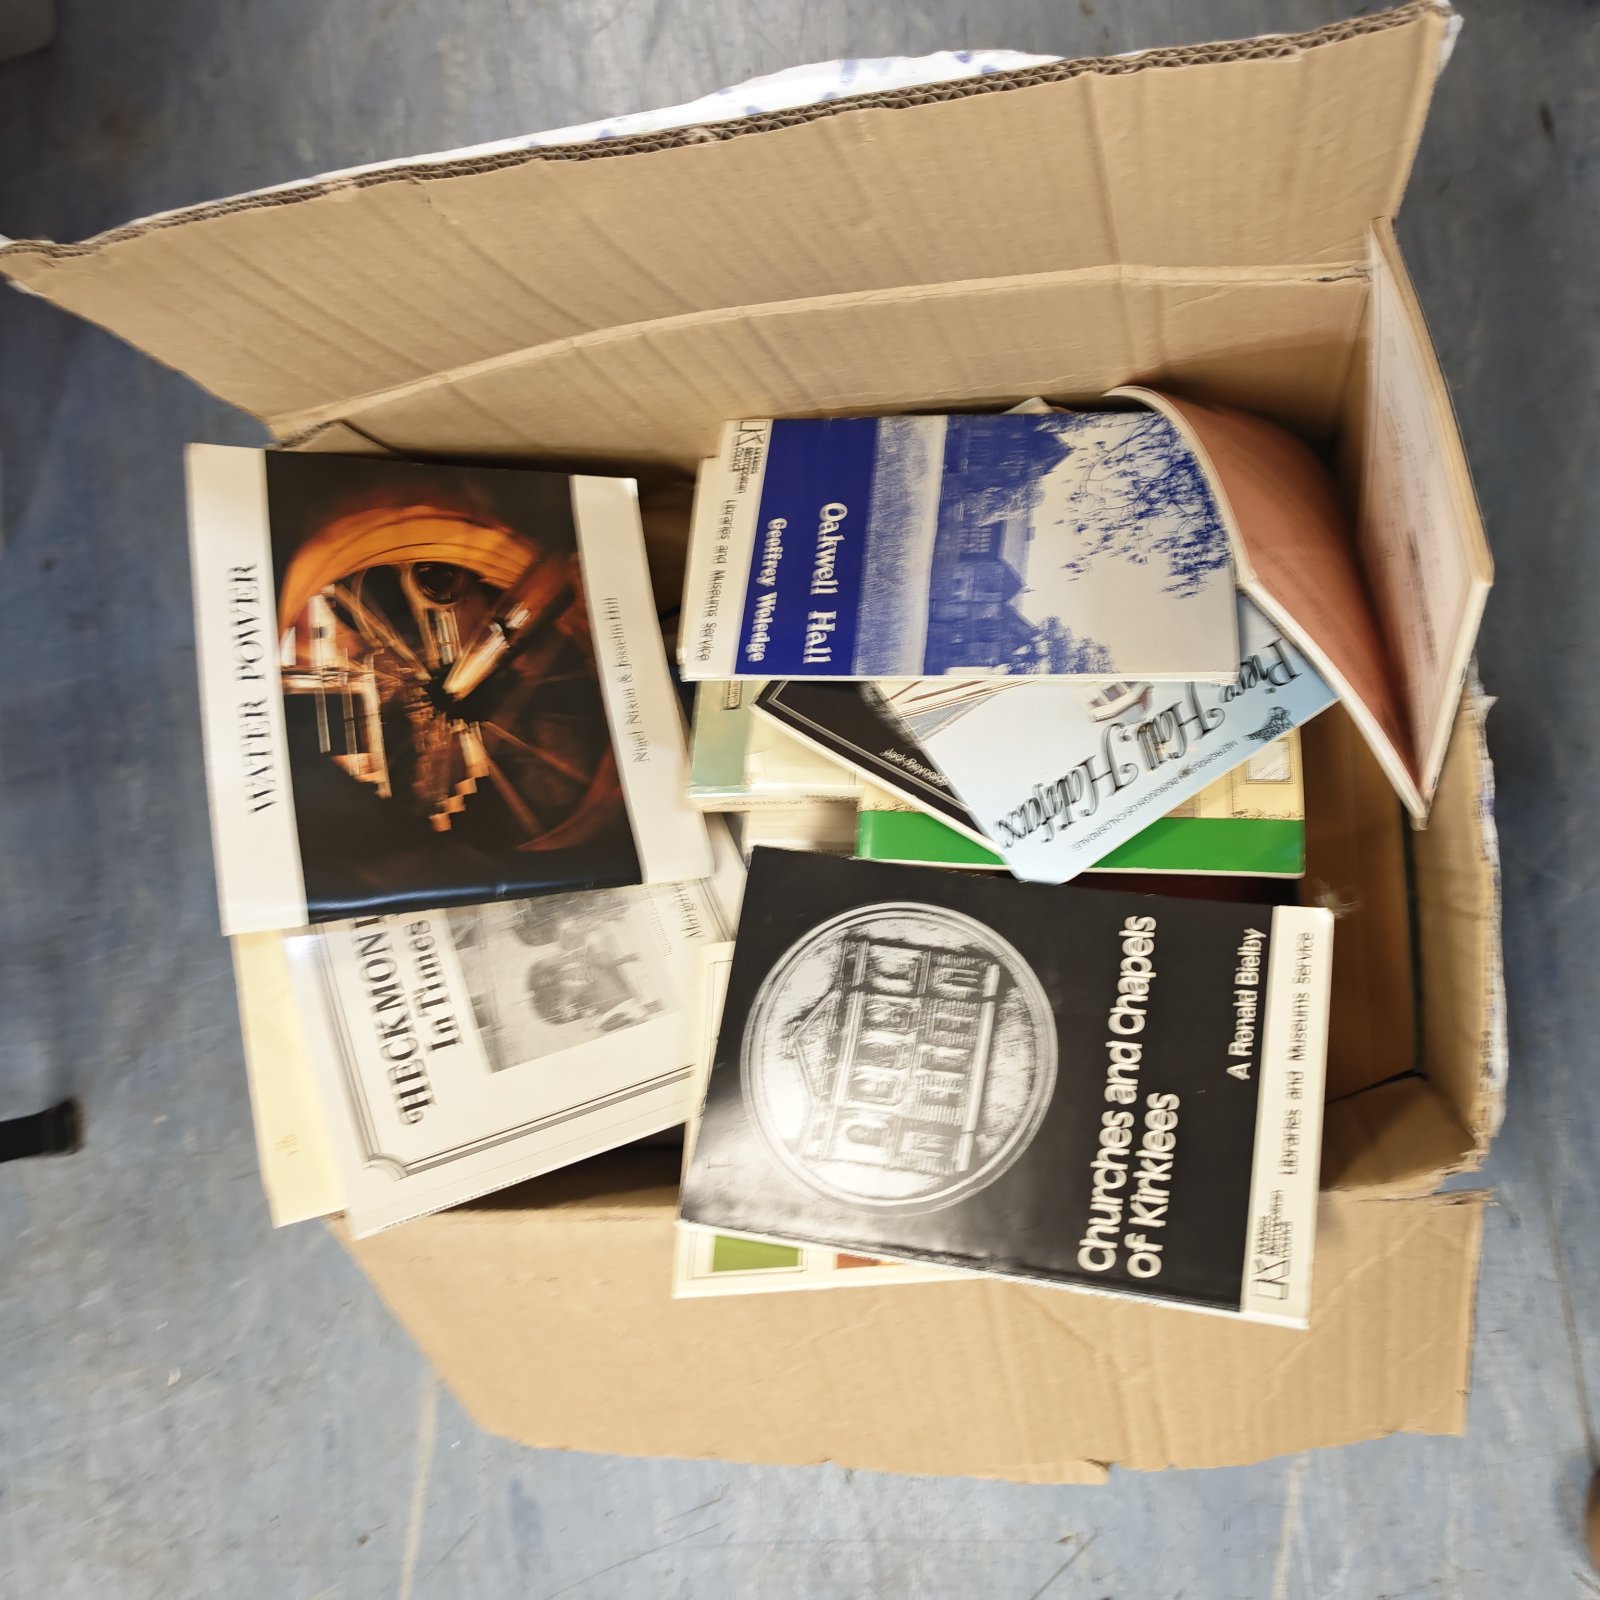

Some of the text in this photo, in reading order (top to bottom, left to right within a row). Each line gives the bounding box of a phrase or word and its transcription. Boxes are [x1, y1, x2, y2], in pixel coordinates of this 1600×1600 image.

[718, 499, 738, 540] Libraries
[712, 544, 728, 564] and
[603, 597, 621, 620] Hill
[705, 569, 726, 617] Museums
[746, 517, 788, 662] Geoffrey Woledge
[803, 502, 848, 664] Oakwell Hall
[227, 561, 277, 816] WATER POWER
[624, 688, 642, 725] Nixon
[627, 731, 650, 763] Nigel
[880, 748, 906, 764] Jack
[996, 722, 1139, 848] Halifax
[1136, 776, 1181, 807] BOROUGH
[1068, 811, 1129, 852] CALDERDALE
[402, 919, 464, 1053] In Times
[1226, 928, 1267, 1081] A Ronald Bielby
[1289, 992, 1310, 1061] Museums
[1078, 915, 1157, 1272] Churches and Chapels
[1287, 1070, 1305, 1100] and
[1279, 1109, 1302, 1175] Libraries
[1124, 1093, 1180, 1279] of Kirklees
